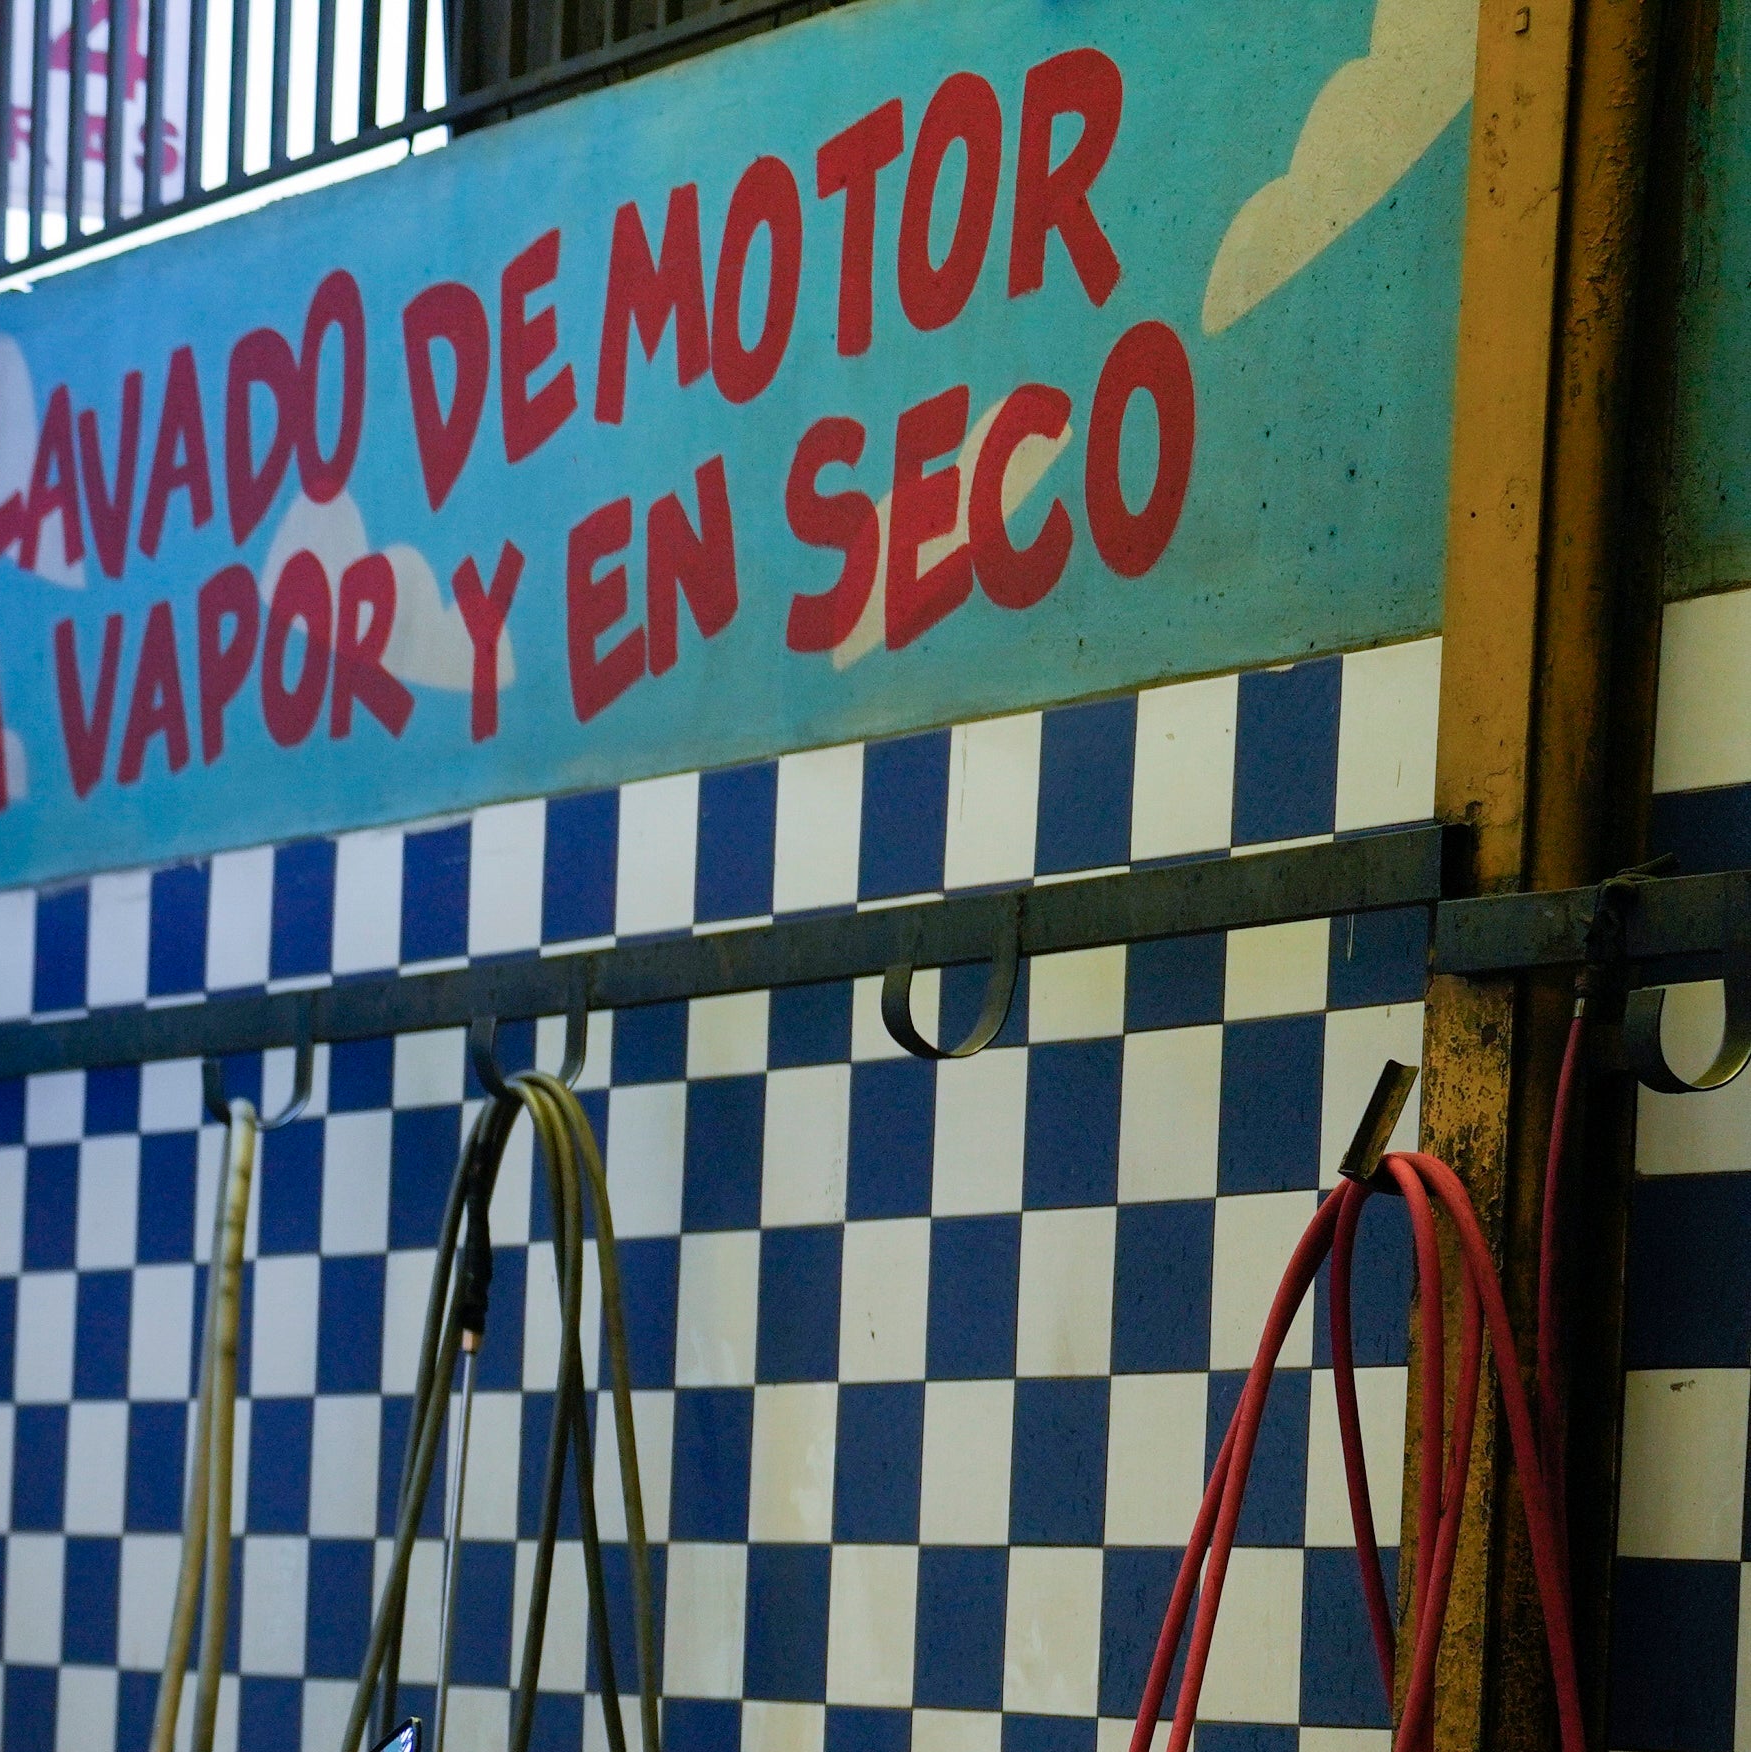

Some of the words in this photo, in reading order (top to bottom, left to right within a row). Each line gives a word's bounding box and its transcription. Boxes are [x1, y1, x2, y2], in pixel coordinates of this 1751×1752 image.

[401, 228, 578, 511] DE
[594, 47, 1124, 425] MOTOR
[55, 549, 414, 801] VAPOR
[453, 538, 525, 745] Y
[565, 453, 739, 723] EN
[784, 319, 1196, 654] SECO
